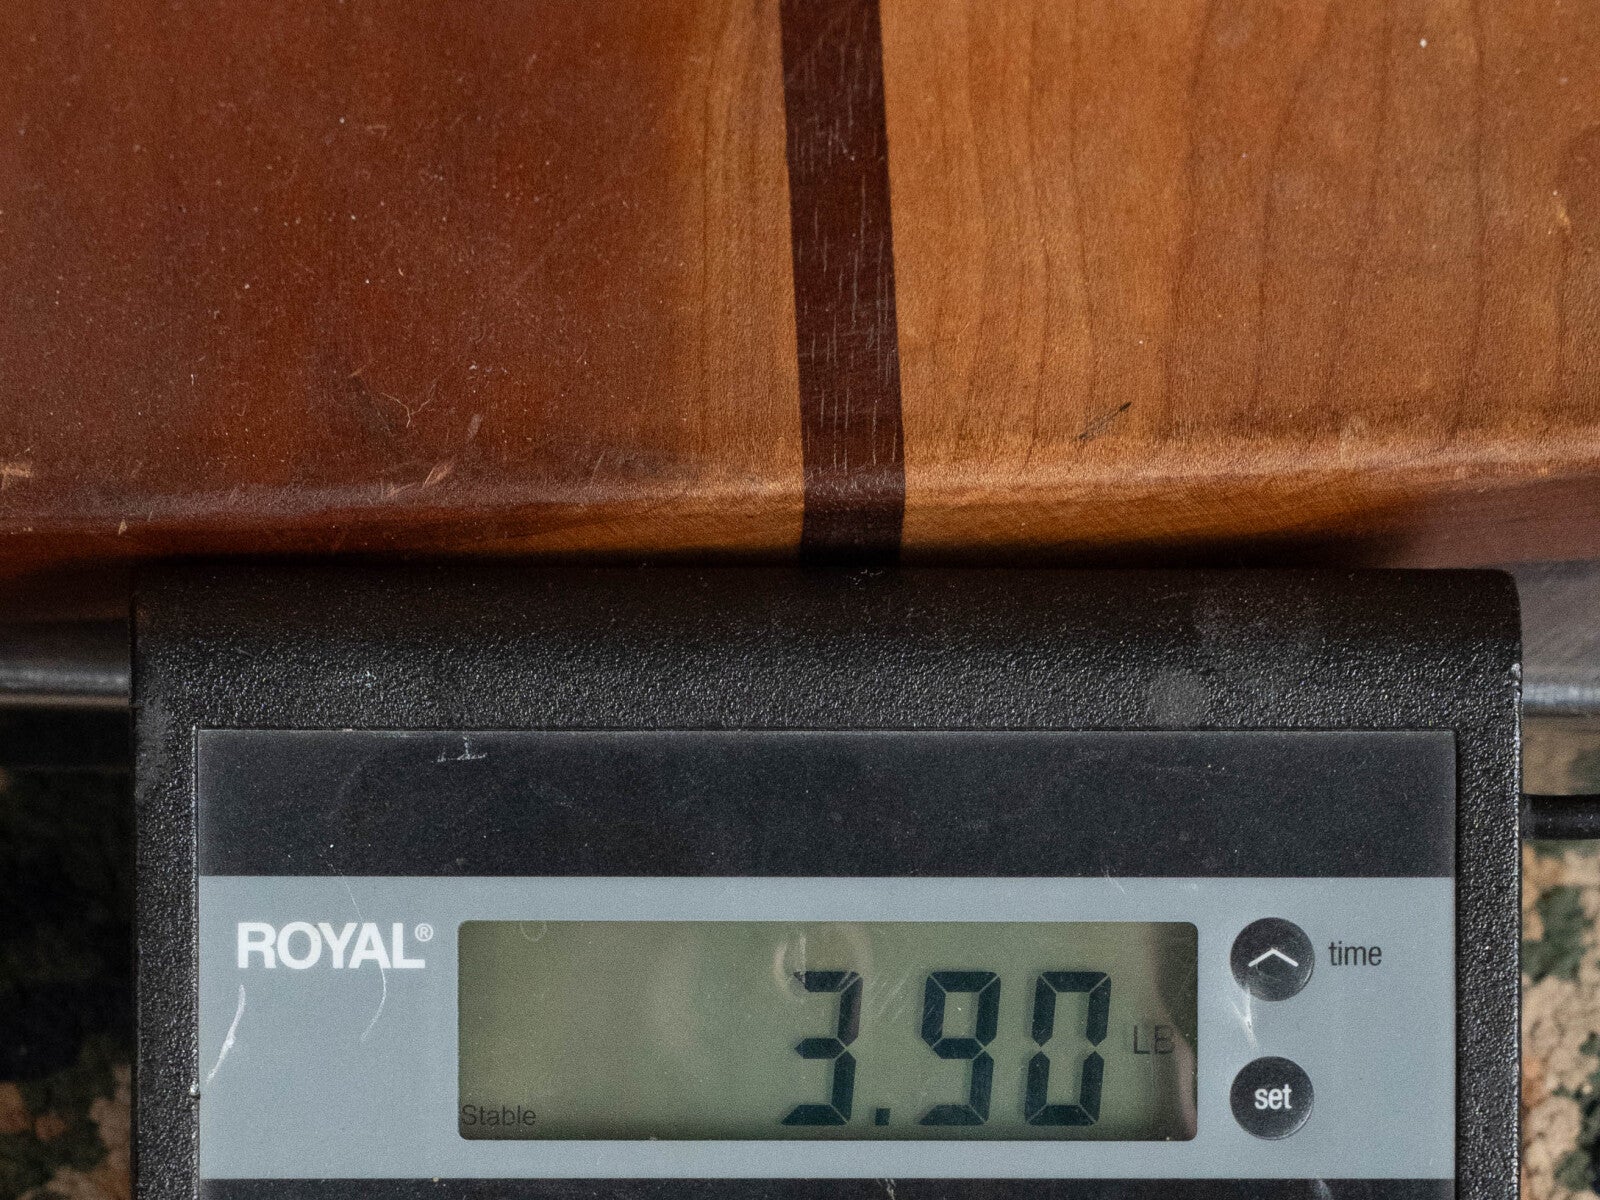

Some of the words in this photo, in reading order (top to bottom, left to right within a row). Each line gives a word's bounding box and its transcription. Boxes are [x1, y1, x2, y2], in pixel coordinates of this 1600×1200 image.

[1328, 942, 1382, 966] time
[781, 971, 1112, 1126] 3.90
[1133, 1024, 1176, 1055] LB
[1254, 1084, 1292, 1110] set
[461, 1104, 537, 1127] Stable
